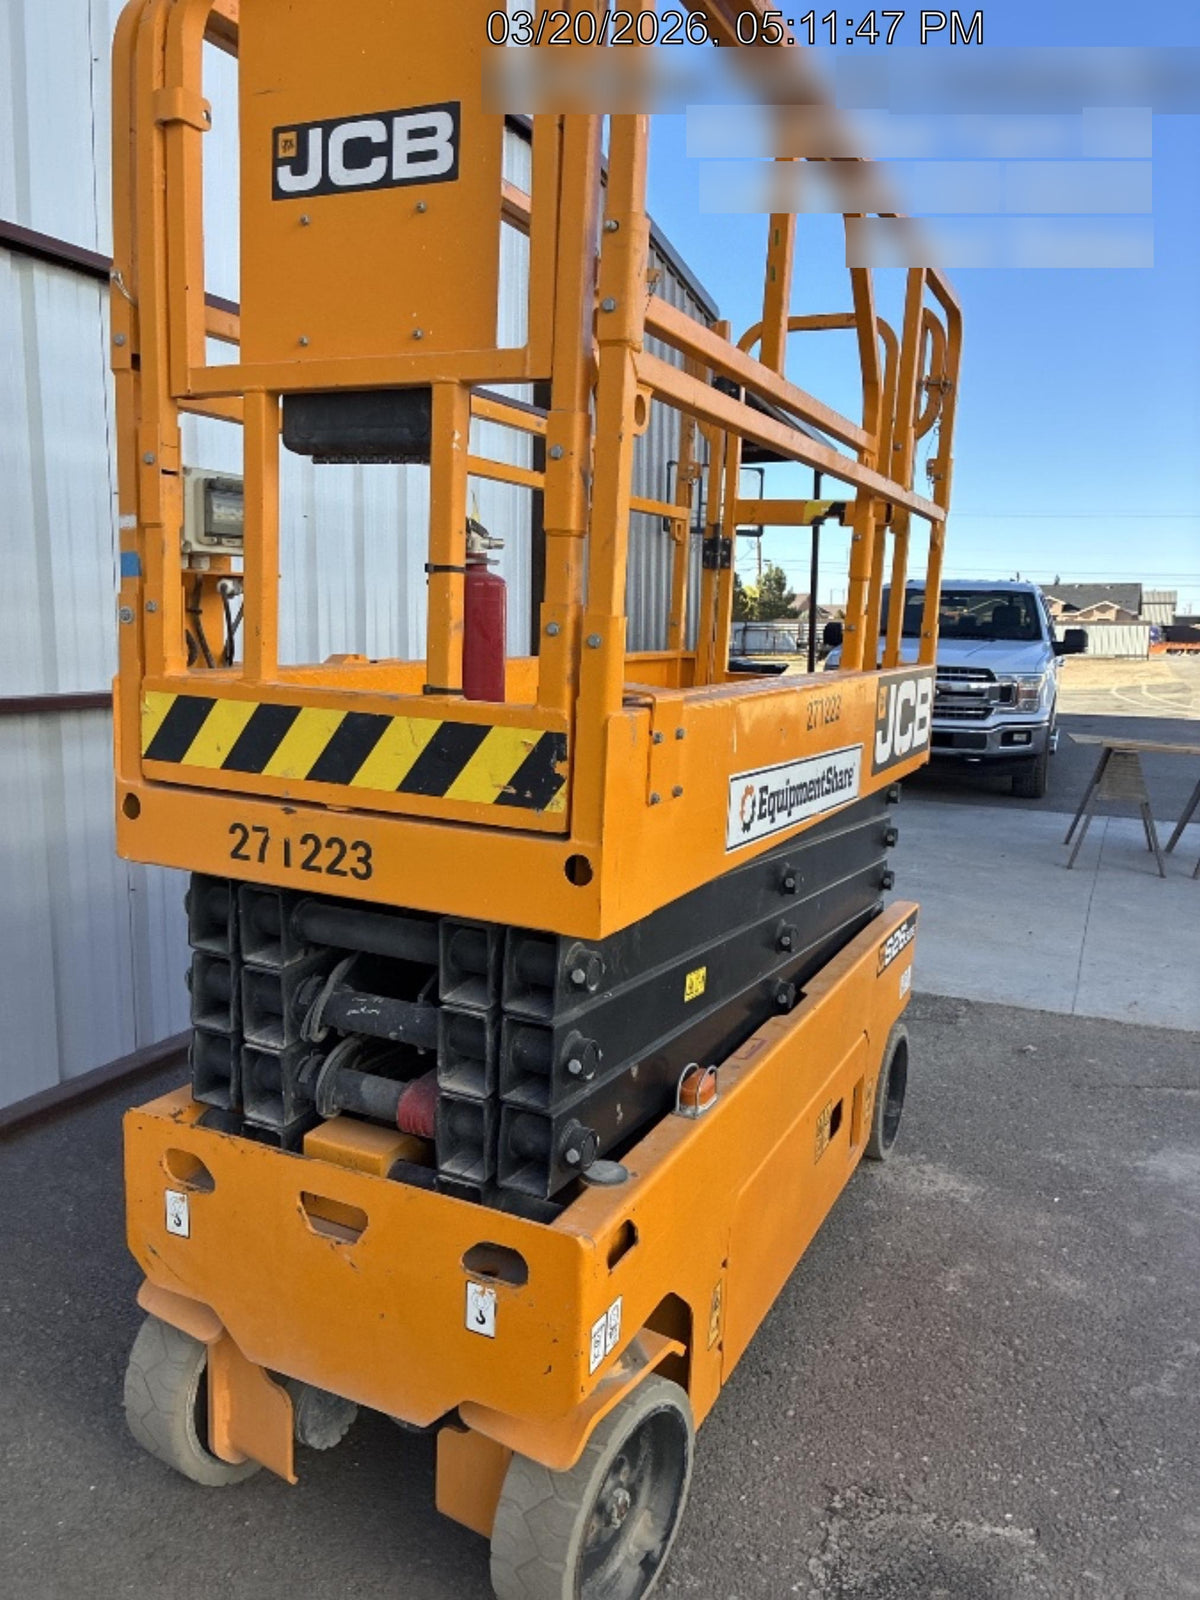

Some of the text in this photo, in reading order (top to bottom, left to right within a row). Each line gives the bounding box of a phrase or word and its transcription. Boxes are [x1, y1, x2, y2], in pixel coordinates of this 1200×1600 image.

[277, 111, 454, 192] JCB
[875, 677, 932, 764] JCB
[757, 765, 854, 824] EquipmentShare
